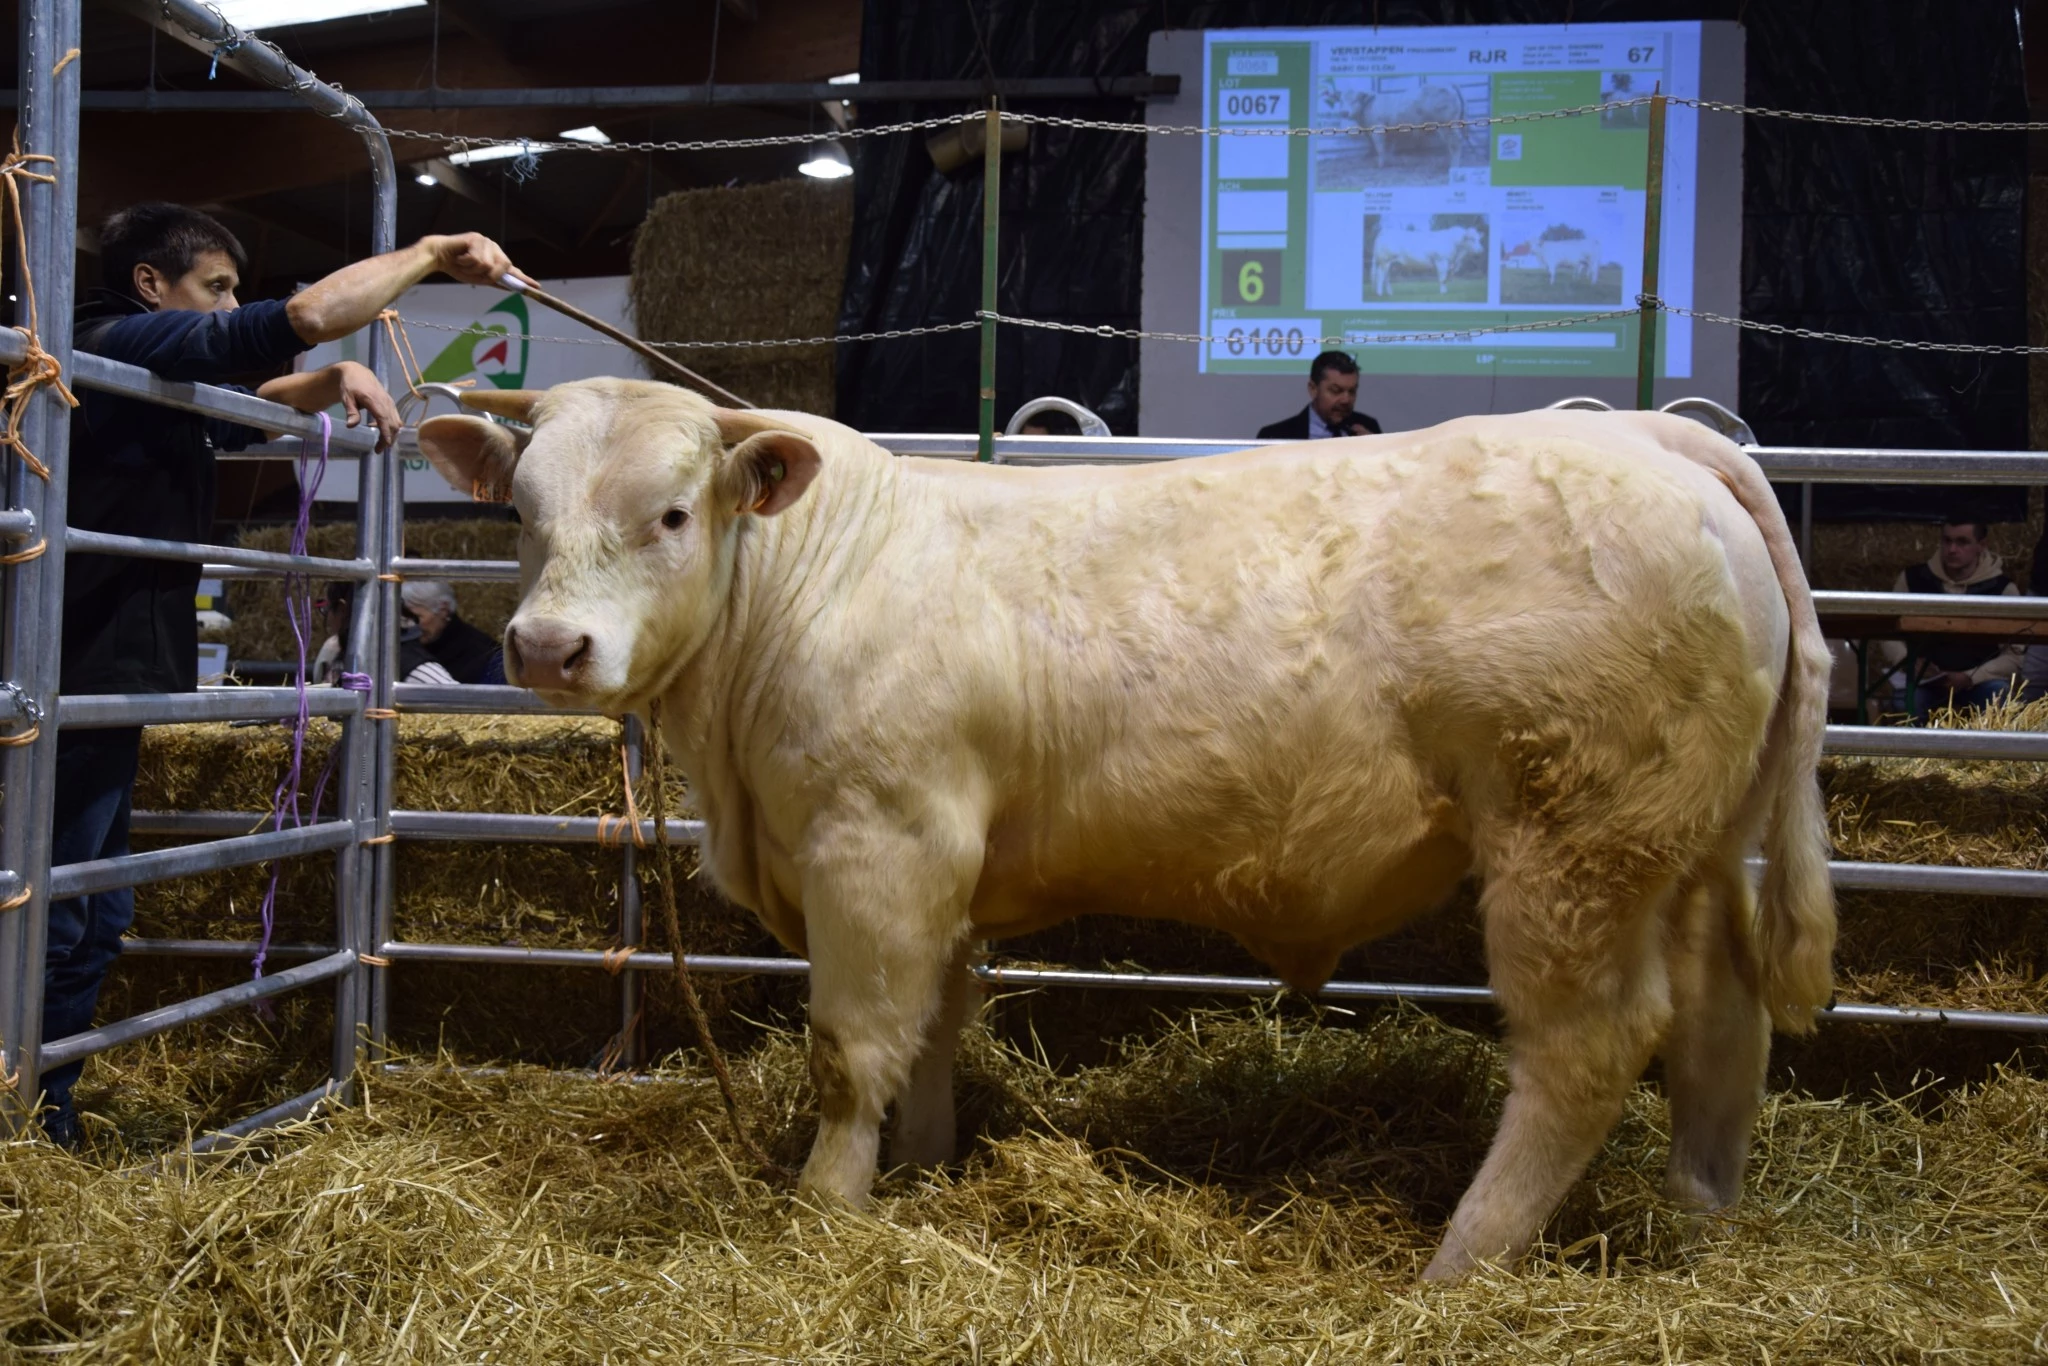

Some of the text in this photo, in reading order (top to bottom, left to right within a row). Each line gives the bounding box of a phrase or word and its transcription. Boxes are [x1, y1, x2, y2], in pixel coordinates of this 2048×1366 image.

[1469, 49, 1507, 64] RJR
[1627, 47, 1655, 63] 67
[1218, 78, 1241, 88] LOT
[1227, 95, 1280, 115] 0067
[1238, 260, 1264, 302] 6
[1212, 309, 1237, 318] PRIX
[1228, 327, 1303, 356] 6100
